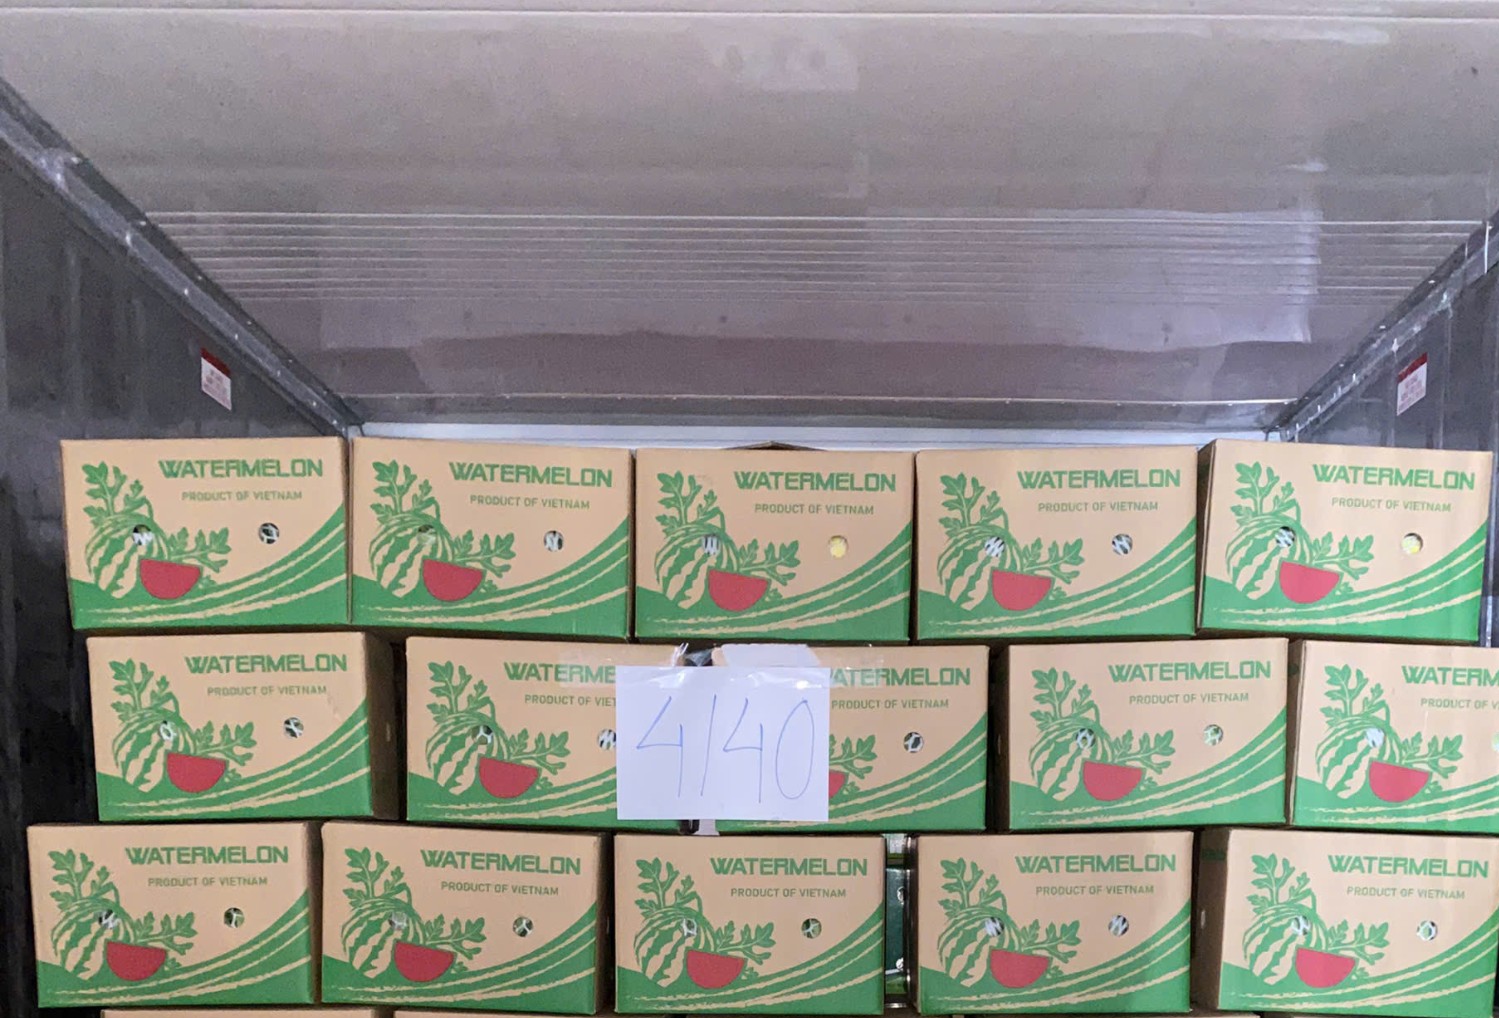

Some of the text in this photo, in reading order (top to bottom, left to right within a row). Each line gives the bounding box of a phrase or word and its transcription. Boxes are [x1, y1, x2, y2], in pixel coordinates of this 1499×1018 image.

[158, 459, 323, 478] WATERMELON
[449, 462, 612, 487] WATERMELON
[1313, 464, 1474, 490] WATERMELON
[735, 472, 895, 491] WATERMELON
[1017, 469, 1180, 489] WATERMELON
[181, 490, 303, 502] PRODUCT OF VIETNAM
[469, 494, 590, 510] PRODUCT OF VIETNAM
[1331, 497, 1452, 513] PRODUCT OF VIETNAM
[1037, 501, 1159, 513] PRODUCT OF VIETNAM
[185, 654, 347, 674] WATERMELON
[504, 662, 615, 683] WATERME
[1108, 661, 1270, 682] WATERMELON
[830, 668, 970, 686] ATERMELON
[524, 694, 616, 707] PRODUCT OF VIET
[831, 698, 949, 710] PRODUCT OF VIETNAM
[1128, 692, 1249, 705] PRODUCT OF VIETNAM
[636, 694, 815, 803] 4/40
[125, 846, 288, 865] WATERMELON
[421, 850, 580, 875] WATERMELON
[1015, 854, 1175, 873] WATERMELON
[710, 858, 867, 876] WATERMELON
[1328, 855, 1488, 878] WATERMELON
[147, 876, 268, 887] PRODUCT OF VIETNAM
[730, 887, 847, 898] PRODUCT OF VIETNAM
